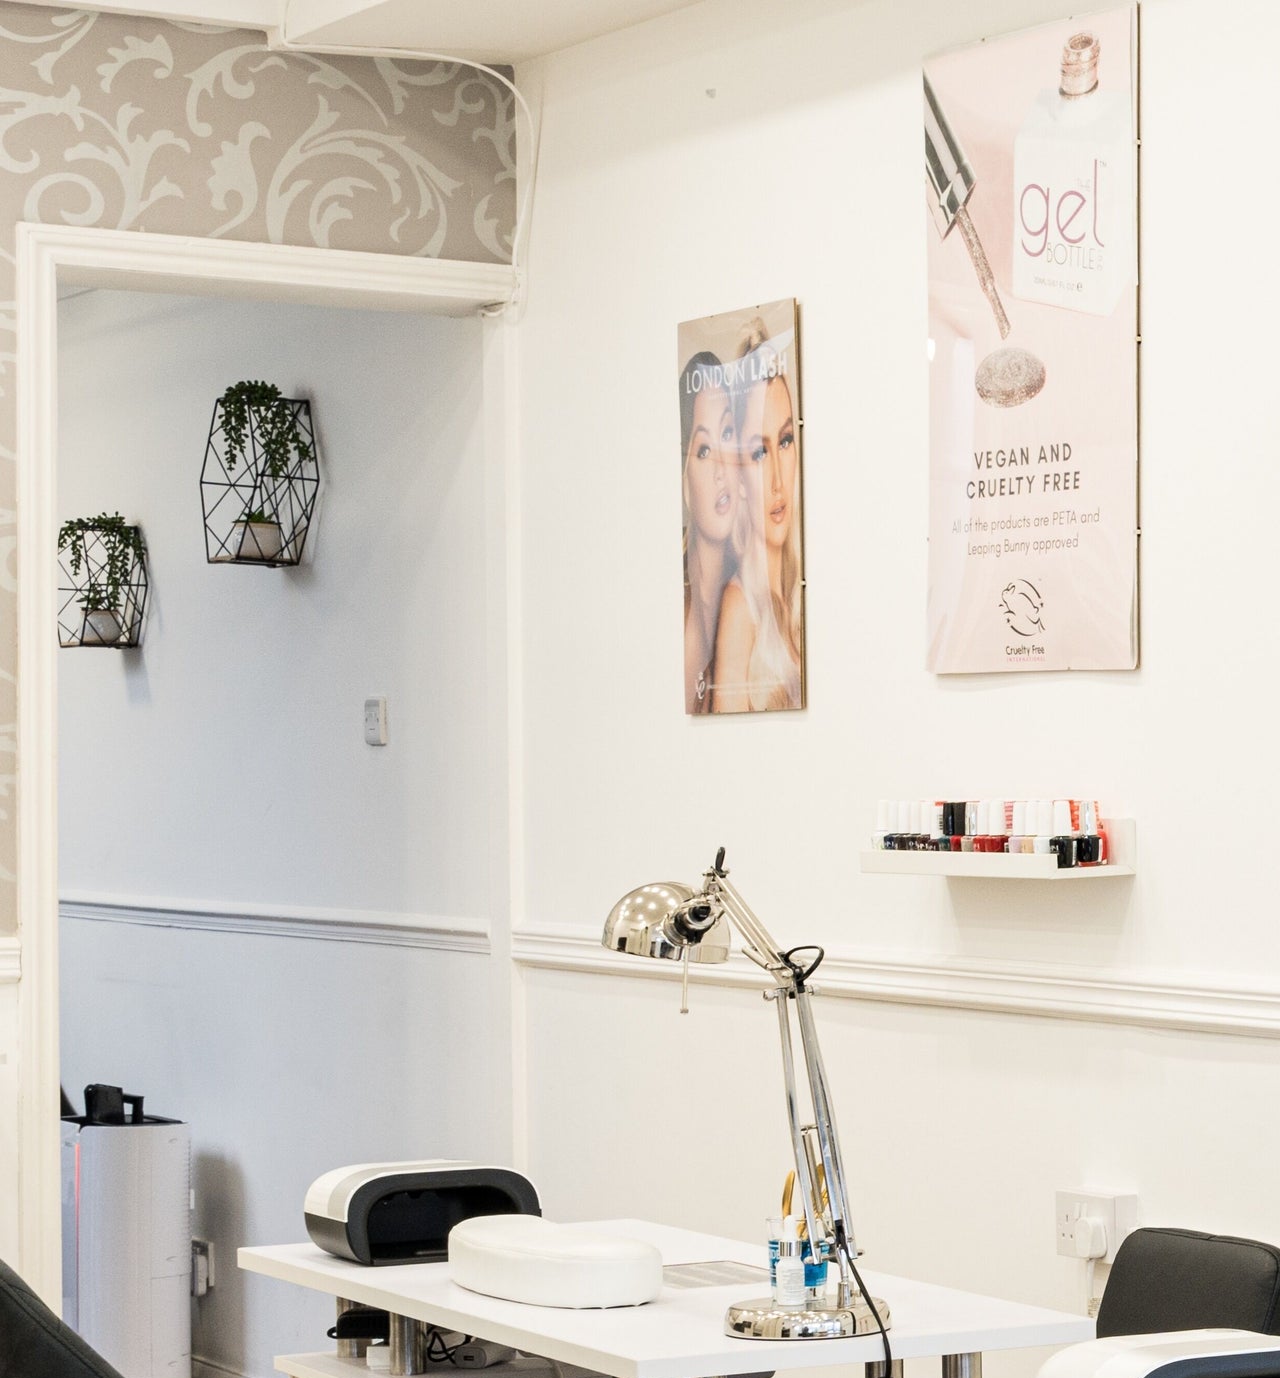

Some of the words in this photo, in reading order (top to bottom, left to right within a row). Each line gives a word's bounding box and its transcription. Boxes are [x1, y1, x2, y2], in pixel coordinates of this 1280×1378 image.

[1020, 160, 1105, 257] gel
[1046, 243, 1096, 270] BOTTLE
[686, 360, 746, 394] LONDON
[750, 352, 788, 381] LASH
[974, 447, 1030, 470] VEGAN
[1038, 442, 1072, 464] AND
[966, 475, 1035, 500] CRUELTY
[1043, 471, 1081, 492] FREE
[964, 518, 974, 534] of
[975, 517, 989, 533] the
[991, 514, 1031, 535] products
[1033, 515, 1049, 528] are
[1052, 510, 1077, 526] PETA
[1081, 507, 1100, 524] and
[967, 540, 1002, 558] Leaping
[1004, 539, 1031, 556] Bunny
[1033, 534, 1079, 555] approved
[1005, 644, 1031, 658] Cruelty
[1032, 643, 1045, 656] Free
